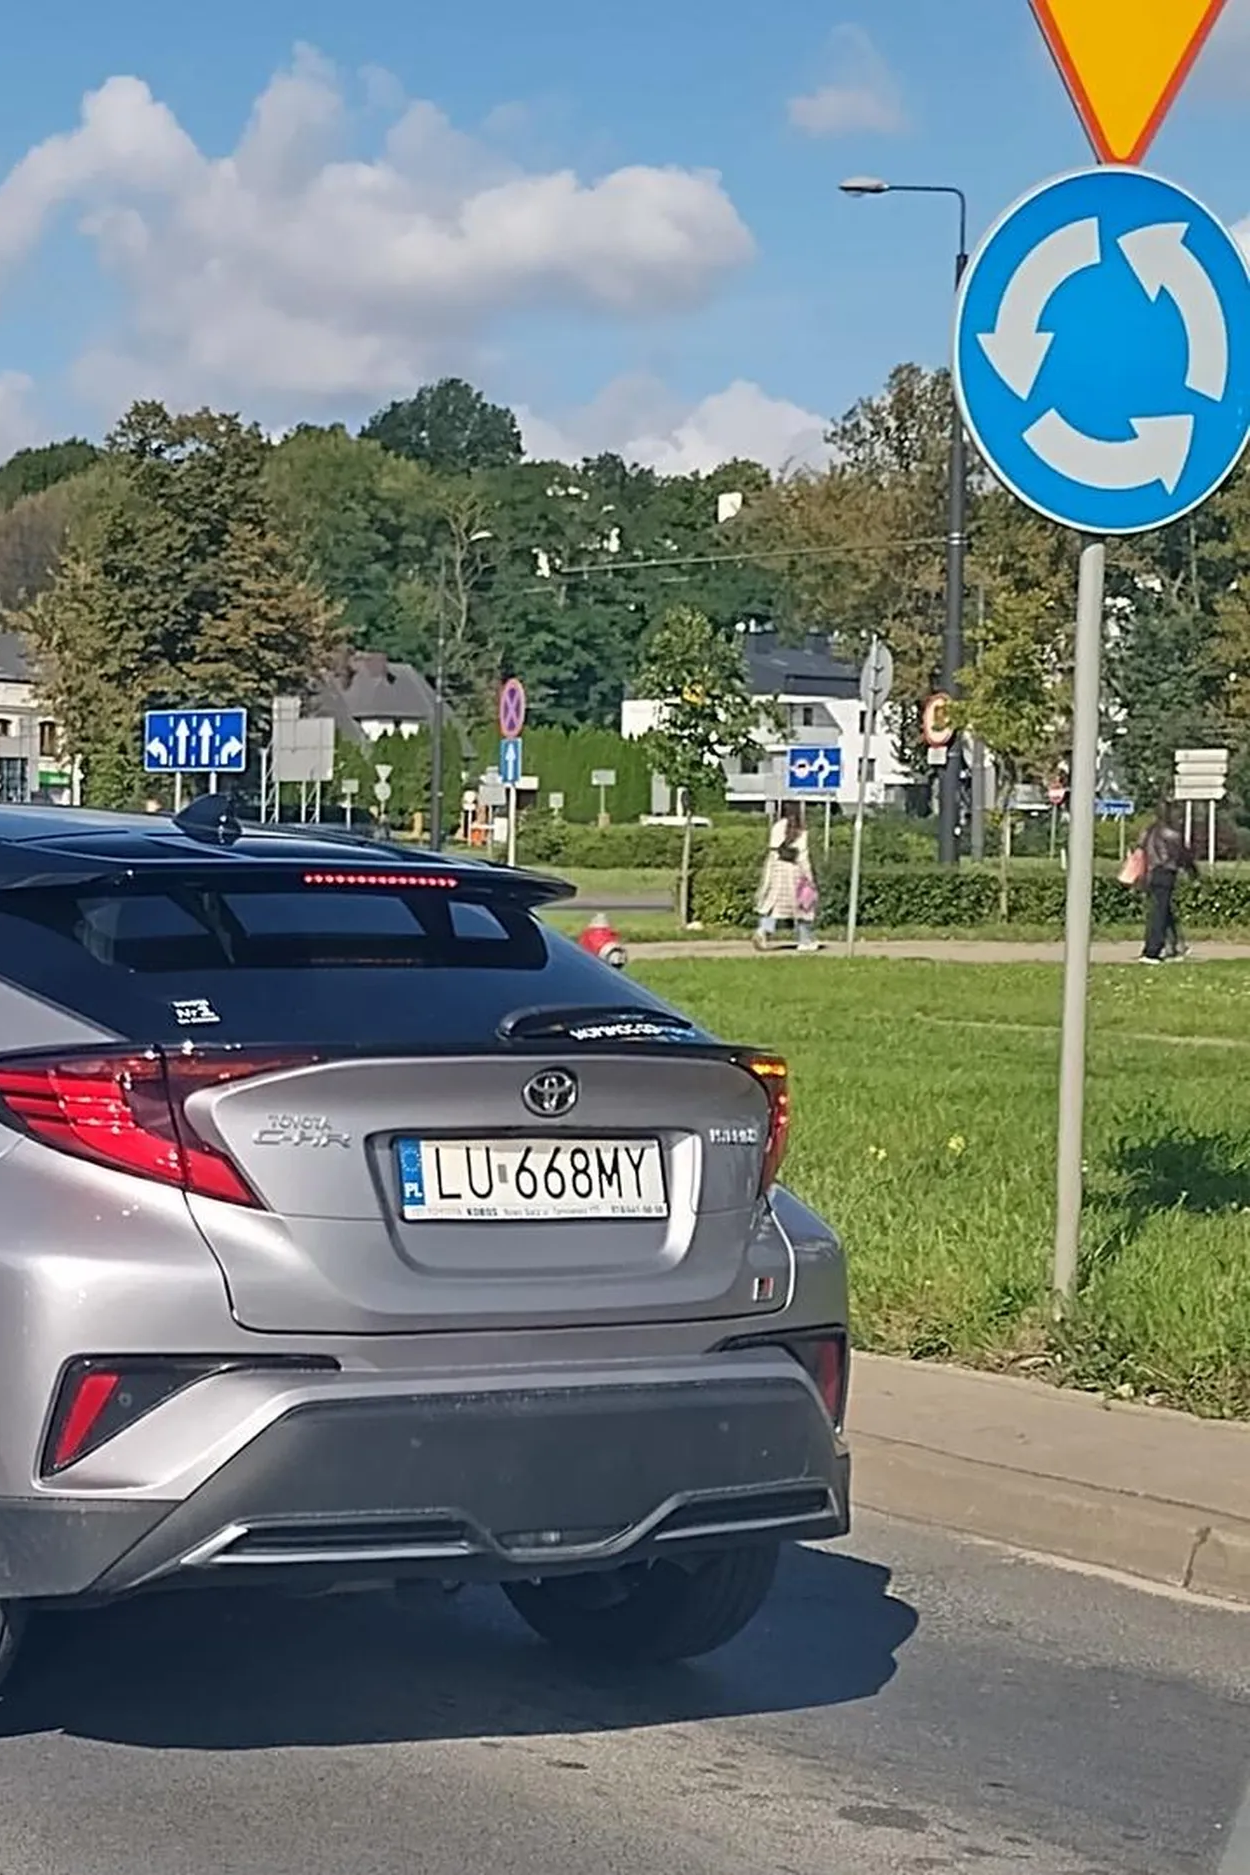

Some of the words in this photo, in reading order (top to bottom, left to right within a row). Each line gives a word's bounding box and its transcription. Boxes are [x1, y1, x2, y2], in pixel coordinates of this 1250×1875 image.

[268, 1115, 332, 1131] TOYOTA
[252, 1130, 351, 1149] C-HR
[435, 1147, 494, 1200] LU
[515, 1146, 647, 1200] 668MY
[404, 1182, 423, 1198] PL
